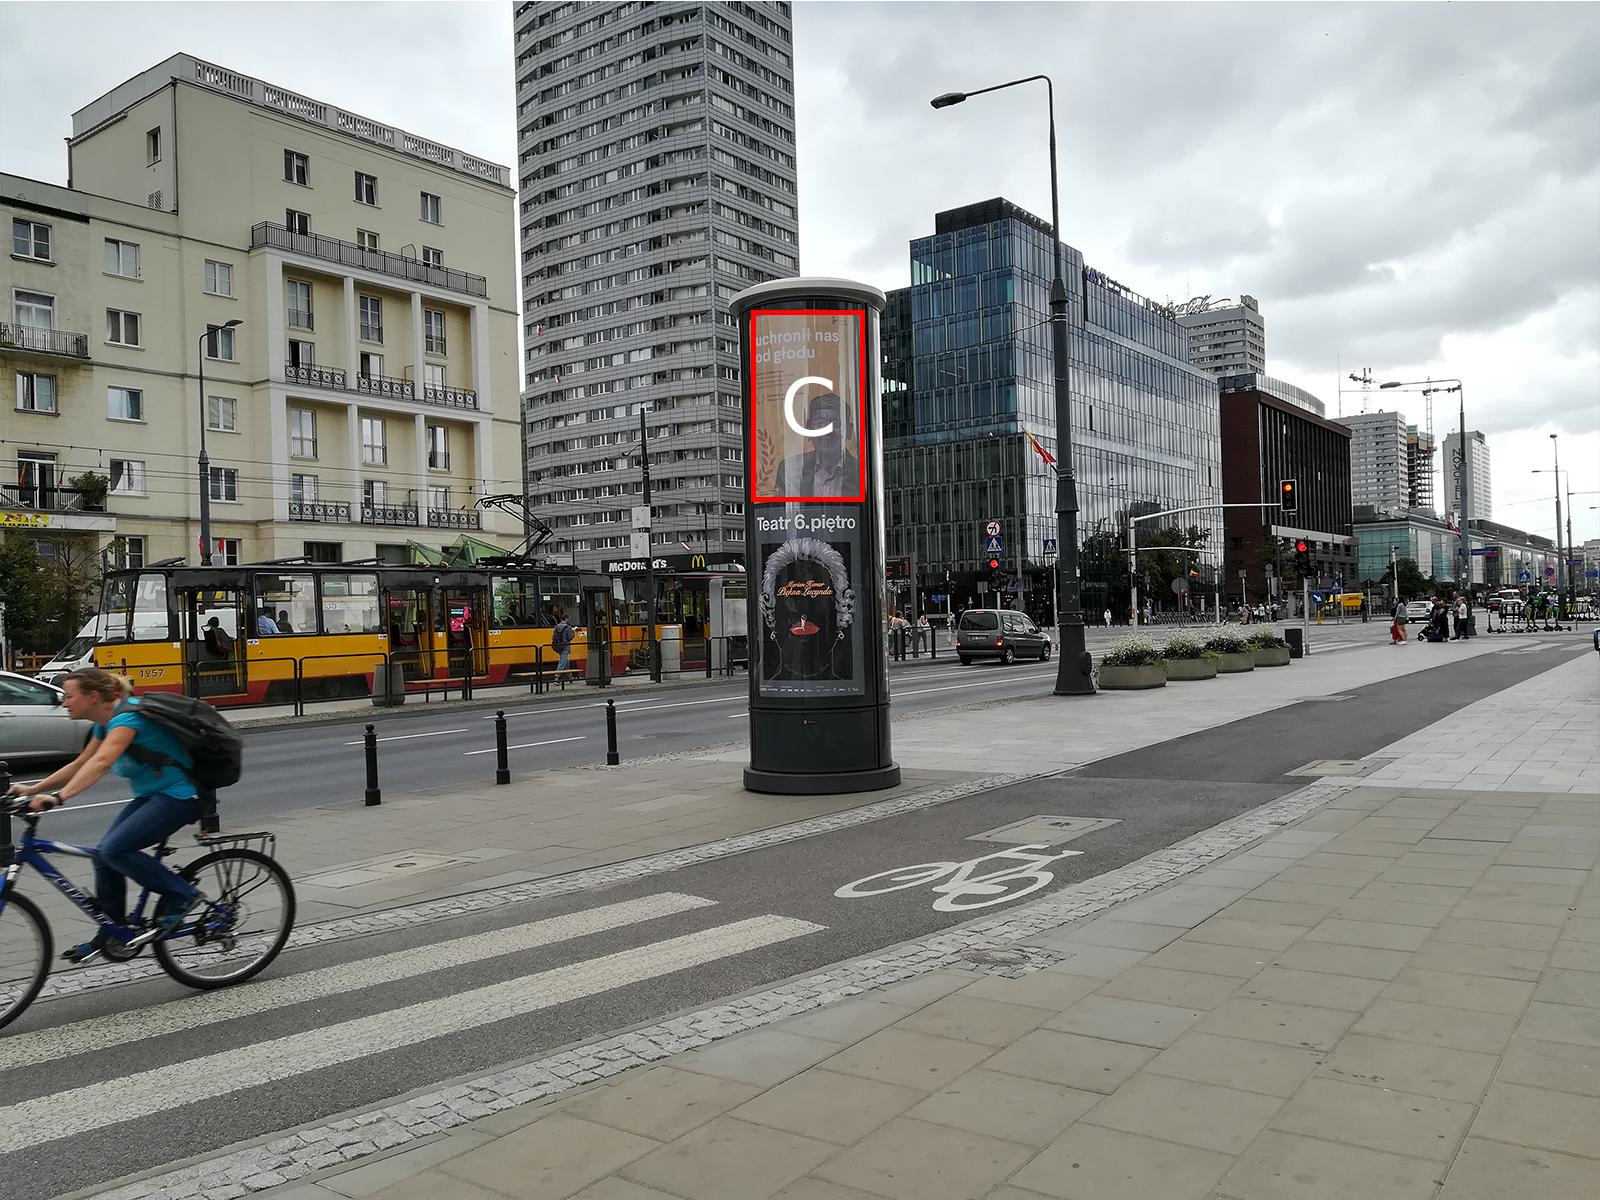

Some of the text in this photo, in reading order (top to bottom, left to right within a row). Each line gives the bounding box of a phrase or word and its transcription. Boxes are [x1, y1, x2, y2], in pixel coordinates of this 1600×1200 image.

[756, 328, 840, 346] uchronił nas
[756, 345, 816, 364] od głodu
[757, 516, 791, 532] Teatr
[140, 669, 164, 679] 1257
